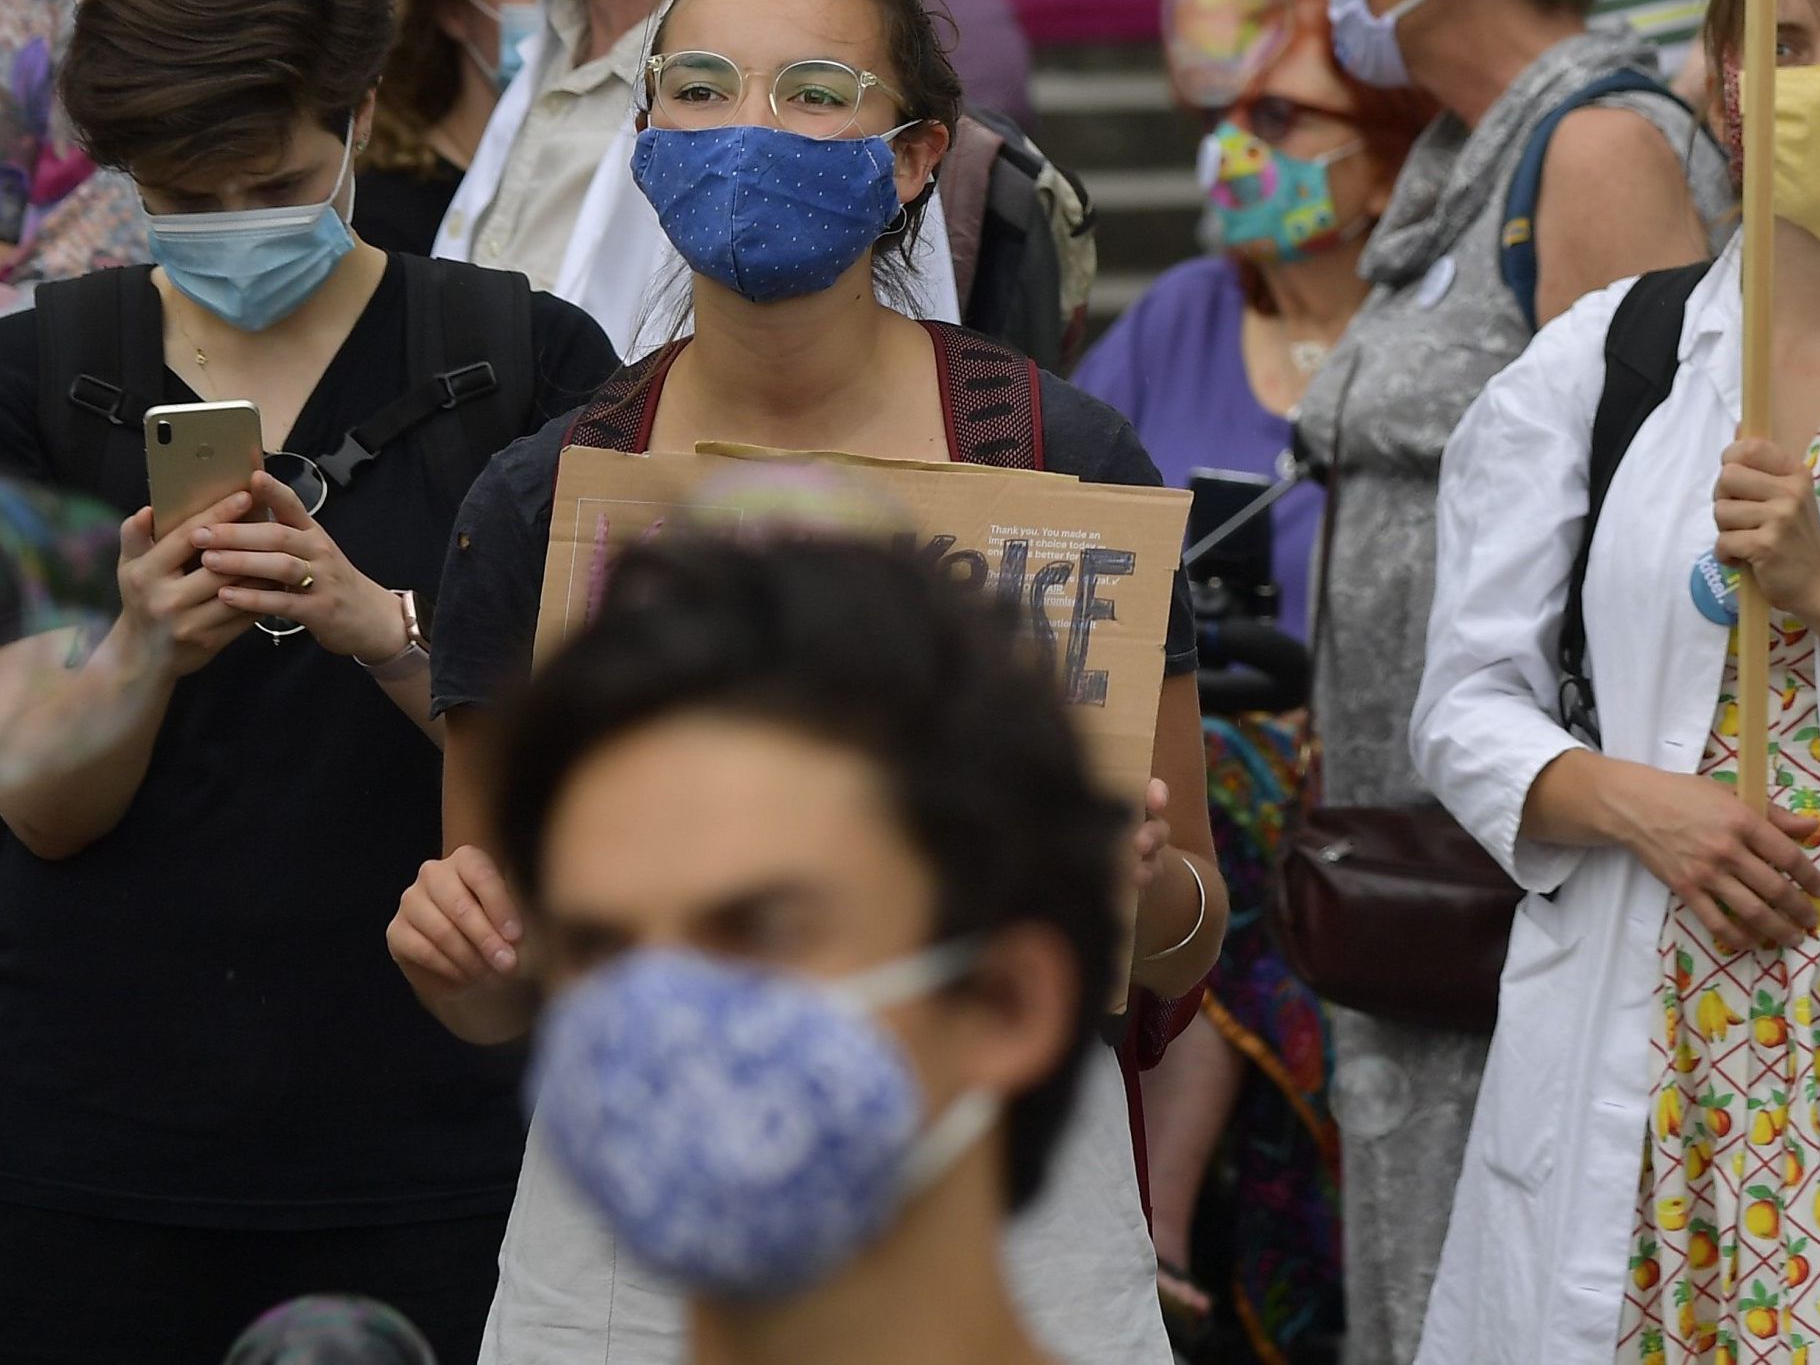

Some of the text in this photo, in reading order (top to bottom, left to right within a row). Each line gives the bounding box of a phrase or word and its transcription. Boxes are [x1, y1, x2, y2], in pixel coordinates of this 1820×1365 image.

[990, 524, 1101, 539] Thank you. You made an
[1036, 538, 1067, 548] choice
[1035, 549, 1063, 560] better
